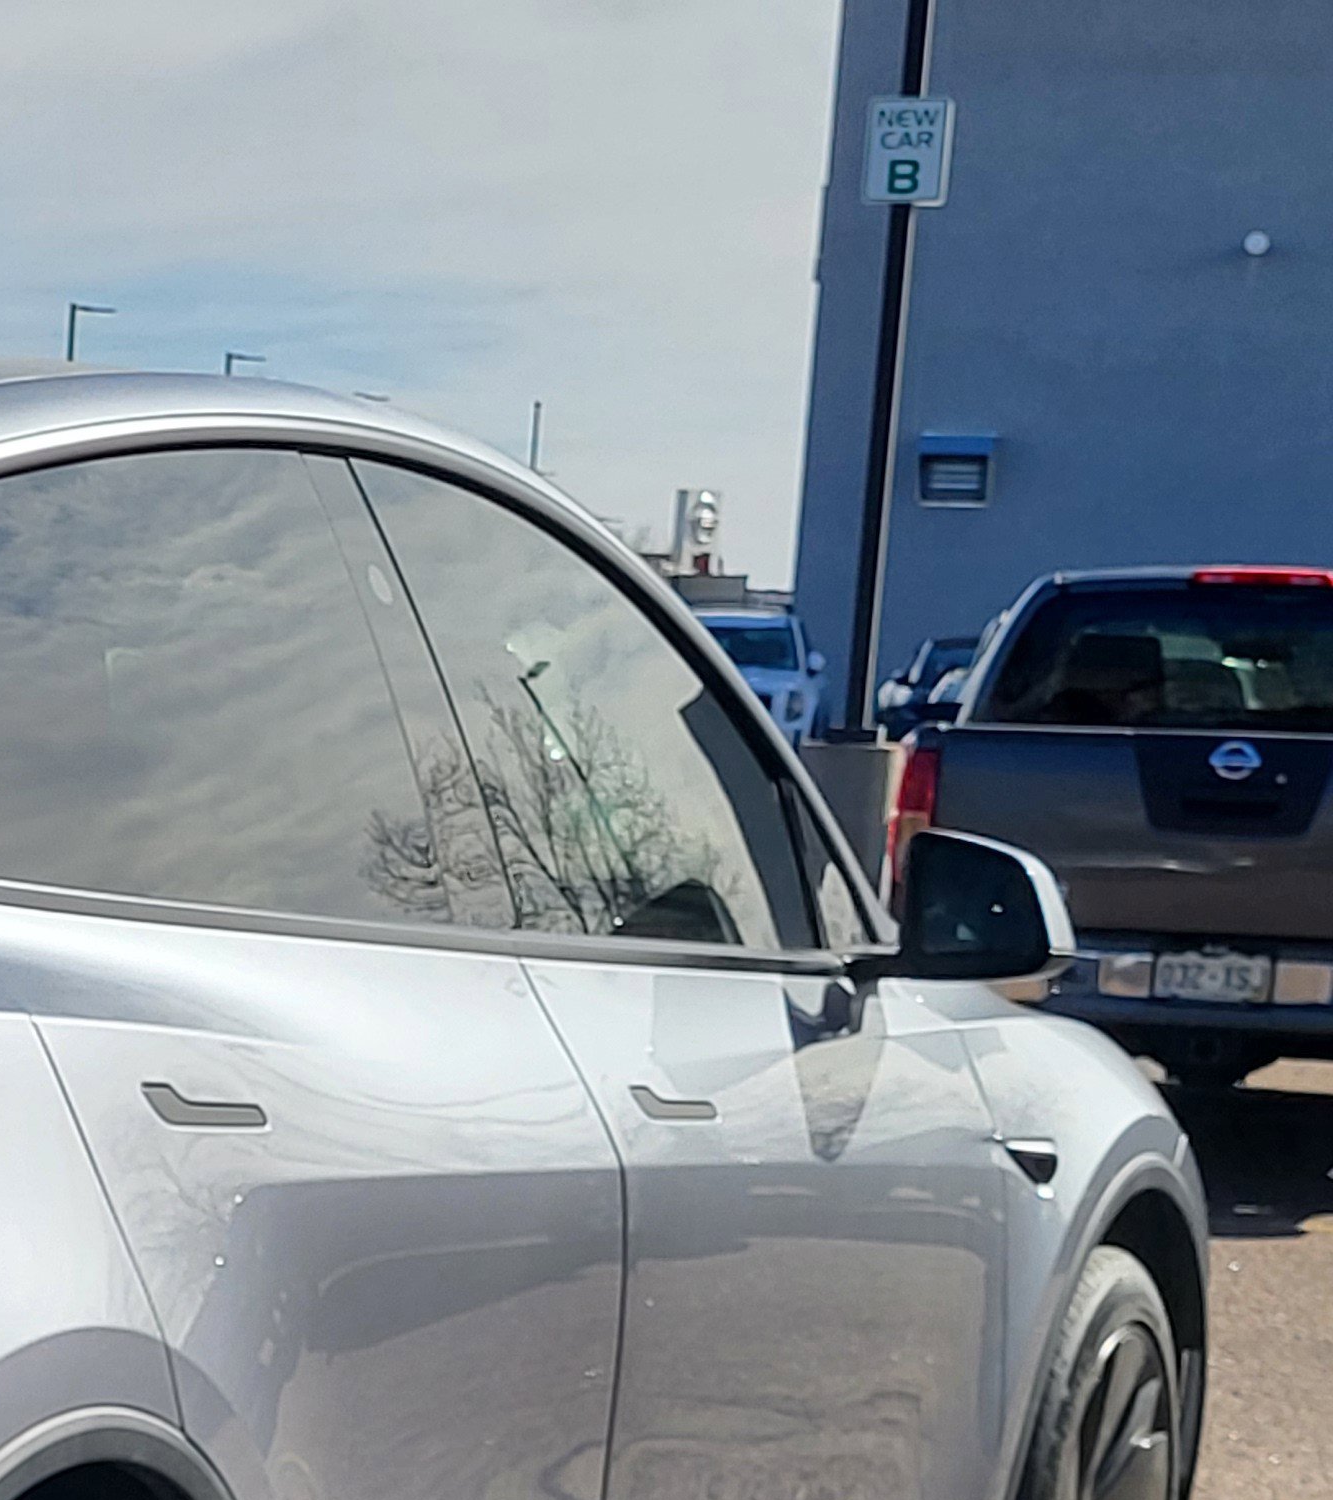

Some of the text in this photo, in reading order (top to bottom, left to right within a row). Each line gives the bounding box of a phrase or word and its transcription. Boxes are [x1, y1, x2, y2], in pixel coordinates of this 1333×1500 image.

[877, 109, 940, 128] NEW
[880, 131, 934, 150] CAR
[887, 159, 920, 194] B
